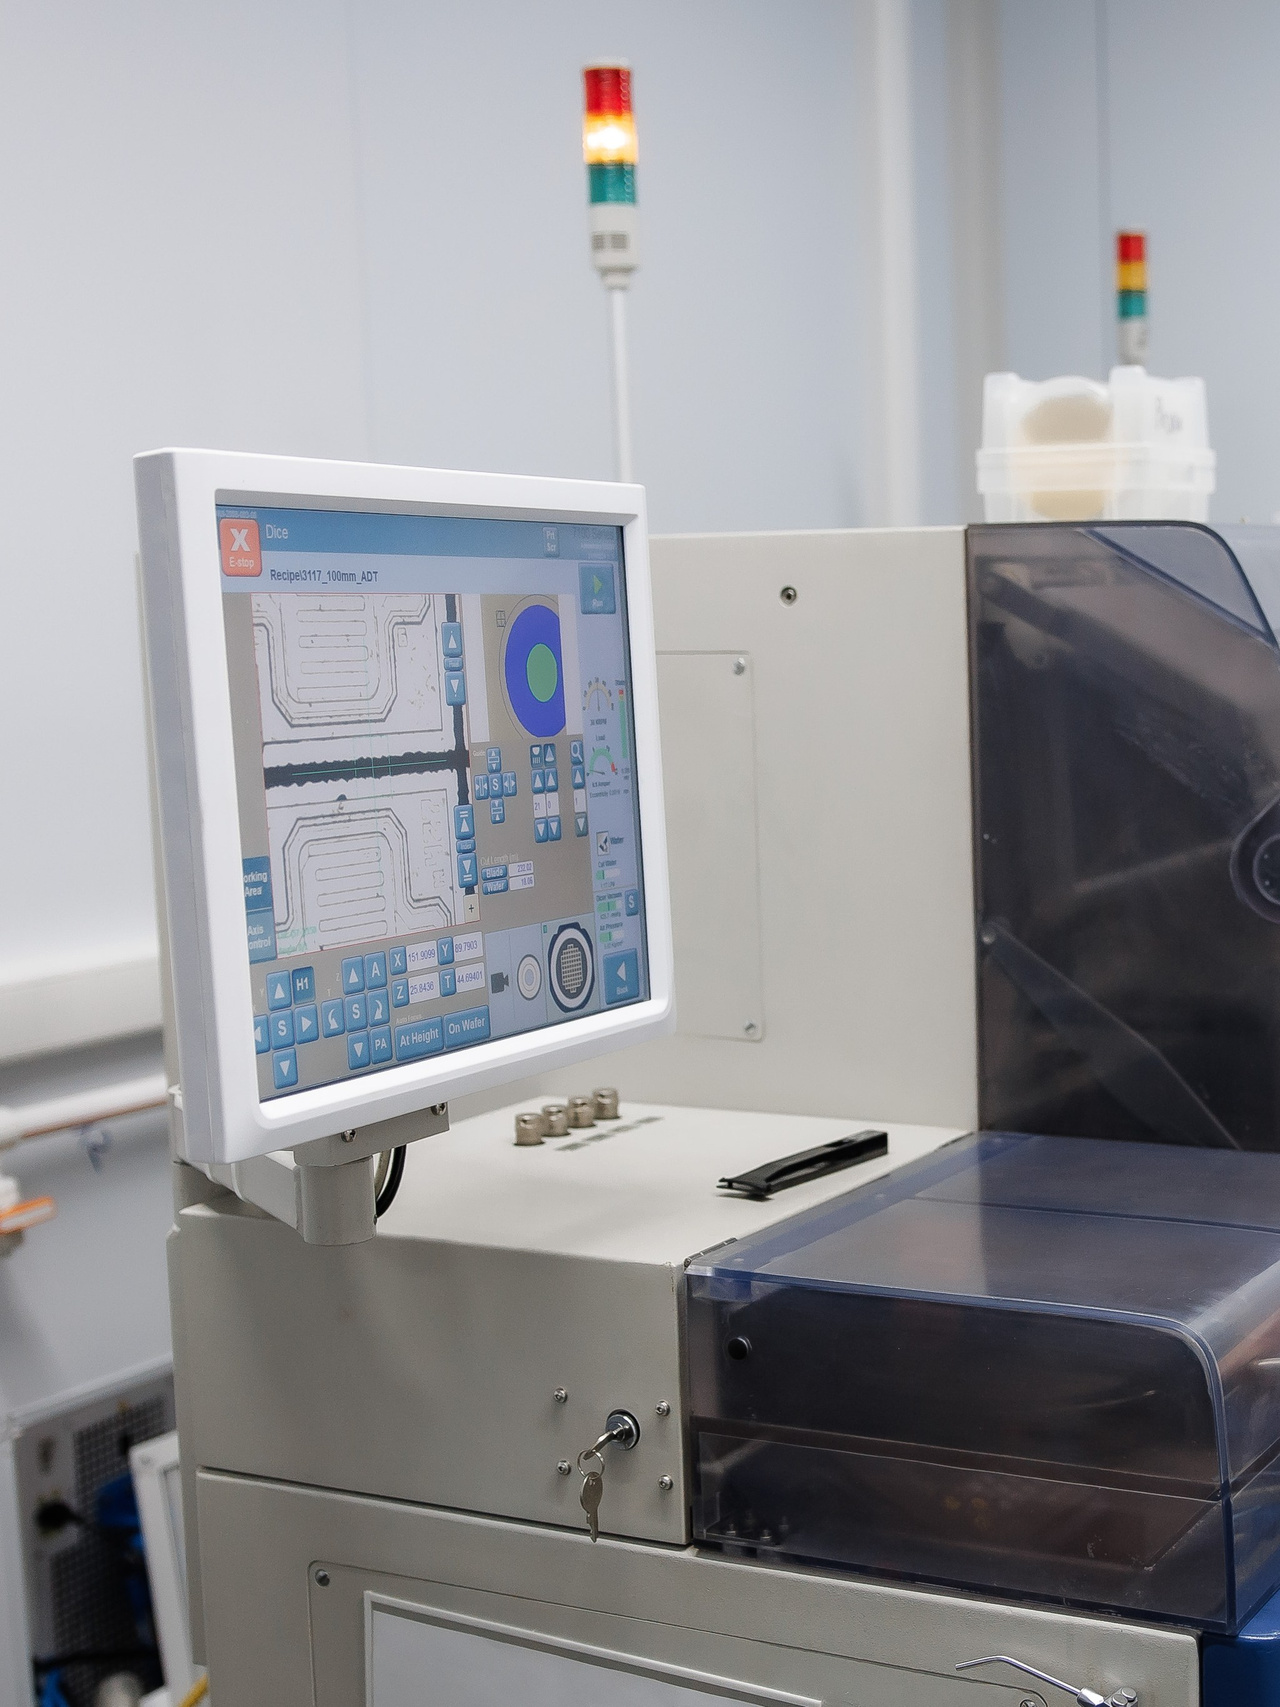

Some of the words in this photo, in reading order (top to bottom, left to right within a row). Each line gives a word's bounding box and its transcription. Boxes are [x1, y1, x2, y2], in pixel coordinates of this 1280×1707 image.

[265, 524, 289, 539] Dice
[547, 543, 556, 552] Scr
[229, 556, 254, 569] E-stop
[270, 569, 378, 585] Recipe\3117_100mm_ADT
[492, 778, 499, 791] S
[534, 802, 541, 811] 21
[243, 871, 268, 883] orking
[486, 868, 504, 878] Blade
[244, 886, 263, 897] Area
[486, 882, 504, 893] Wafer
[628, 895, 635, 908] S
[247, 925, 264, 936] Axis
[248, 937, 271, 949] ontrol
[394, 953, 401, 967] X
[408, 948, 436, 962] 151.9099
[441, 943, 449, 957] Y
[455, 940, 478, 953] 89.7903
[371, 961, 381, 978] A
[296, 977, 309, 991] H1
[396, 985, 404, 1000] Z
[410, 981, 434, 995] 25.8436
[444, 975, 451, 989] T
[456, 970, 483, 984] 44.69401
[352, 1003, 360, 1019] S
[277, 1020, 287, 1036] S
[448, 1023, 460, 1035] On
[461, 1017, 485, 1032] Wafer
[400, 1034, 410, 1047] At
[411, 1027, 439, 1044] Height
[375, 1038, 387, 1051] PA
